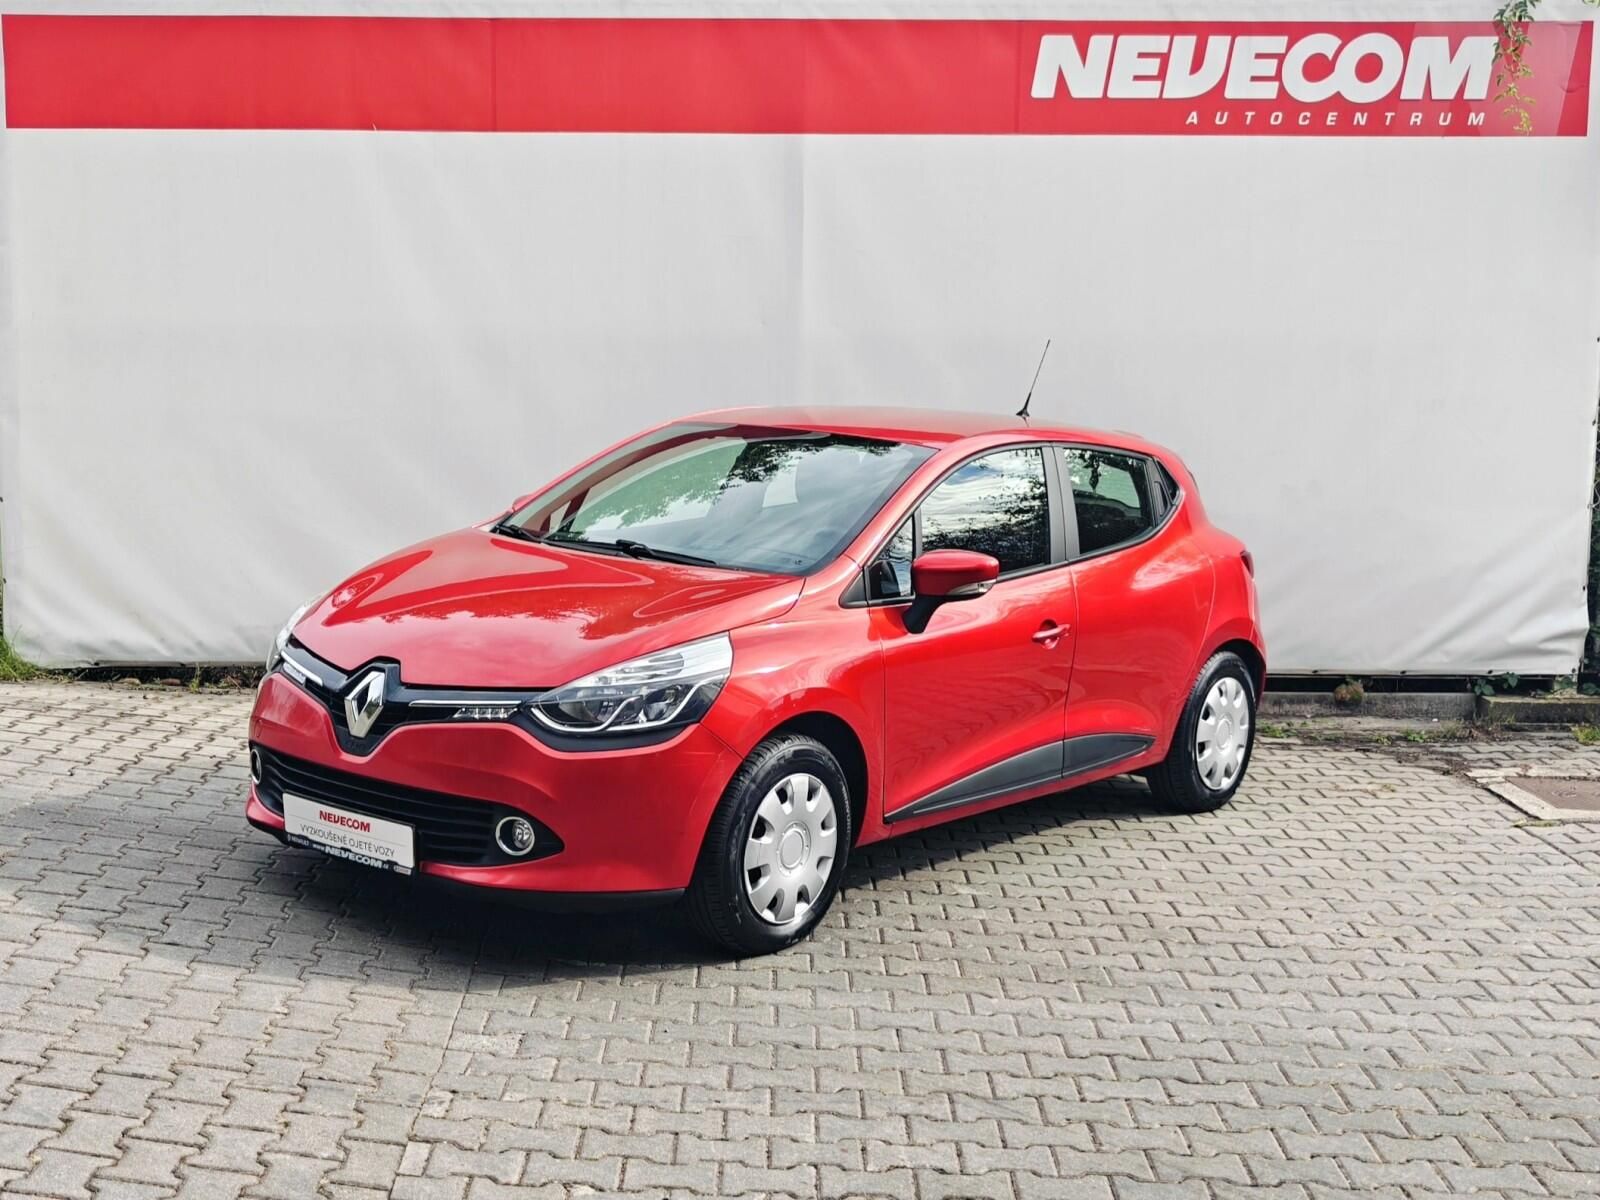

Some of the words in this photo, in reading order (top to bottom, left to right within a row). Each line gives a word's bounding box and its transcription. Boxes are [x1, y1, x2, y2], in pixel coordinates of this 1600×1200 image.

[1030, 32, 1498, 104] NEVECOM
[1185, 111, 1487, 126] AUTOCENTRUM
[319, 810, 371, 833] NEVECOM
[300, 824, 348, 844] VYZKOUŠENÉ
[348, 837, 373, 853] OJETÉ
[372, 844, 396, 857] VOZY
